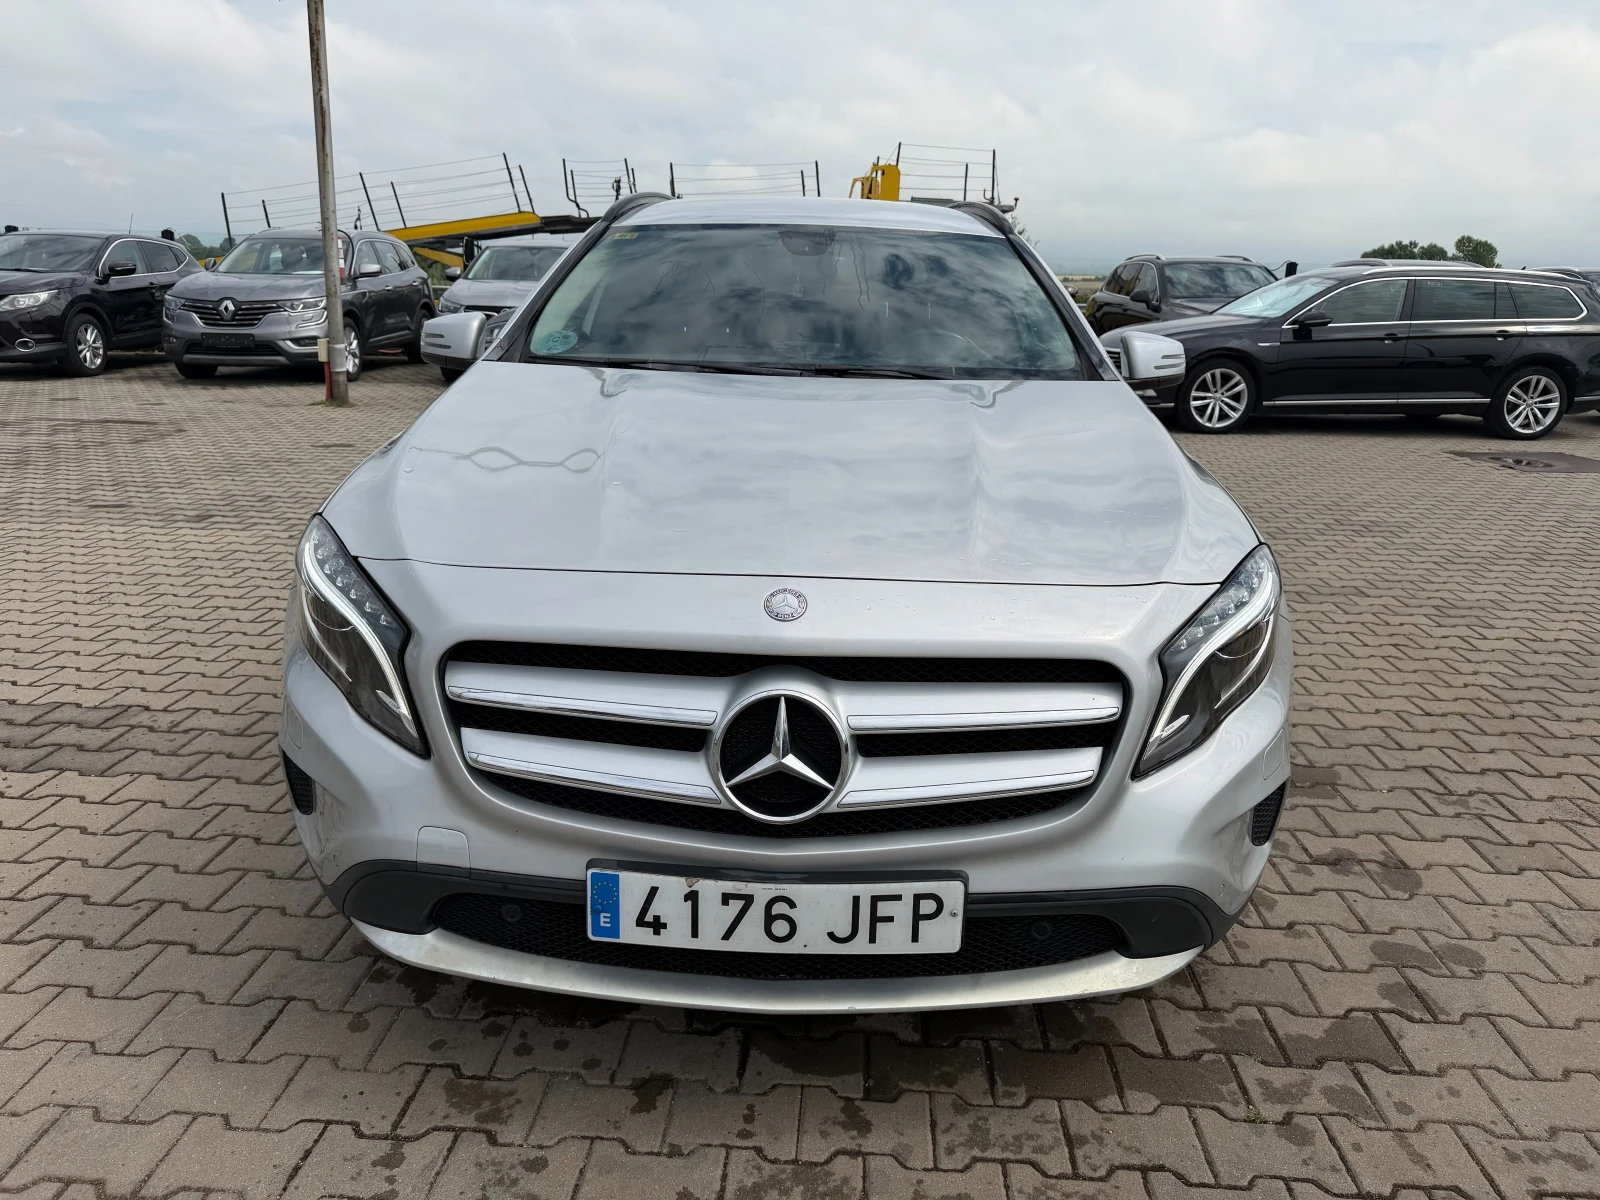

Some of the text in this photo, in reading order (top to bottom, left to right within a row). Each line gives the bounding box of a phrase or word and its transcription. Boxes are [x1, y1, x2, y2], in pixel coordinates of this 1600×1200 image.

[599, 912, 612, 928] E
[635, 886, 945, 944] 4176 JFP
